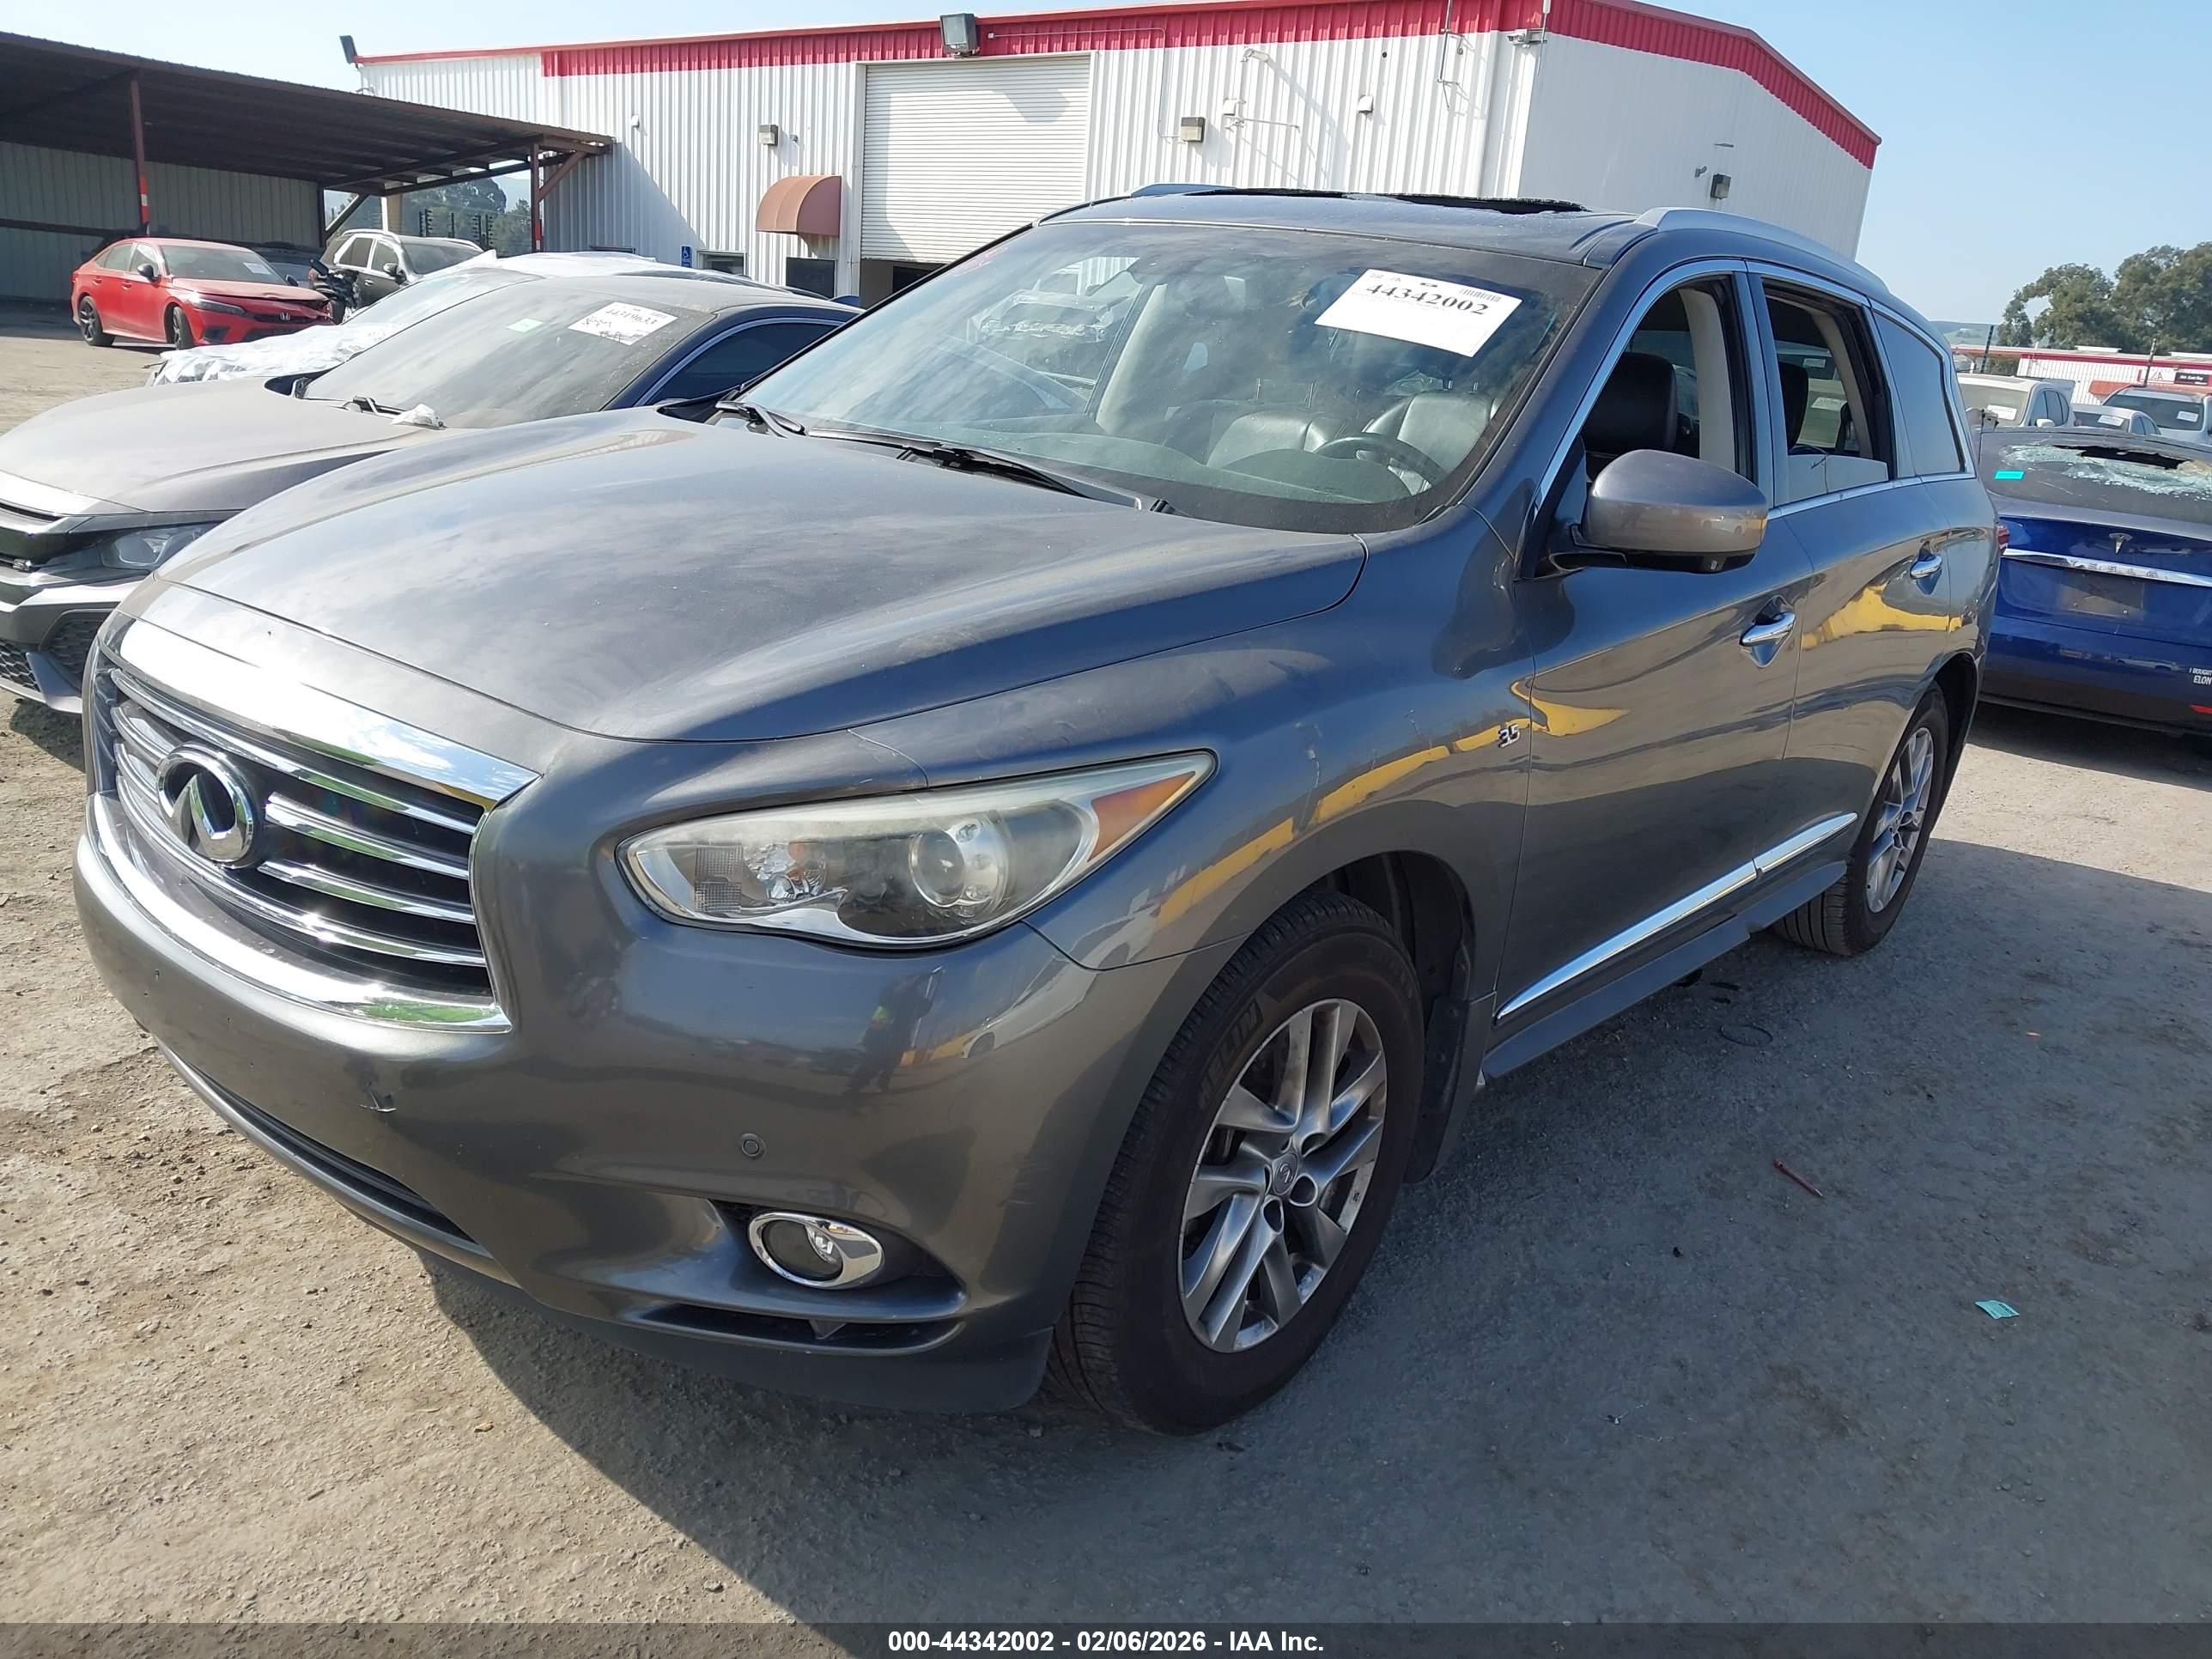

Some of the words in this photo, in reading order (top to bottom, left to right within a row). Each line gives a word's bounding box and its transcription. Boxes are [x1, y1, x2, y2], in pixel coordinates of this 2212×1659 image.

[1366, 284, 1489, 315] 44342002
[2070, 559, 2159, 579] TESLA
[2192, 667, 2212, 677] BOUGHT
[2193, 675, 2212, 685] ELON
